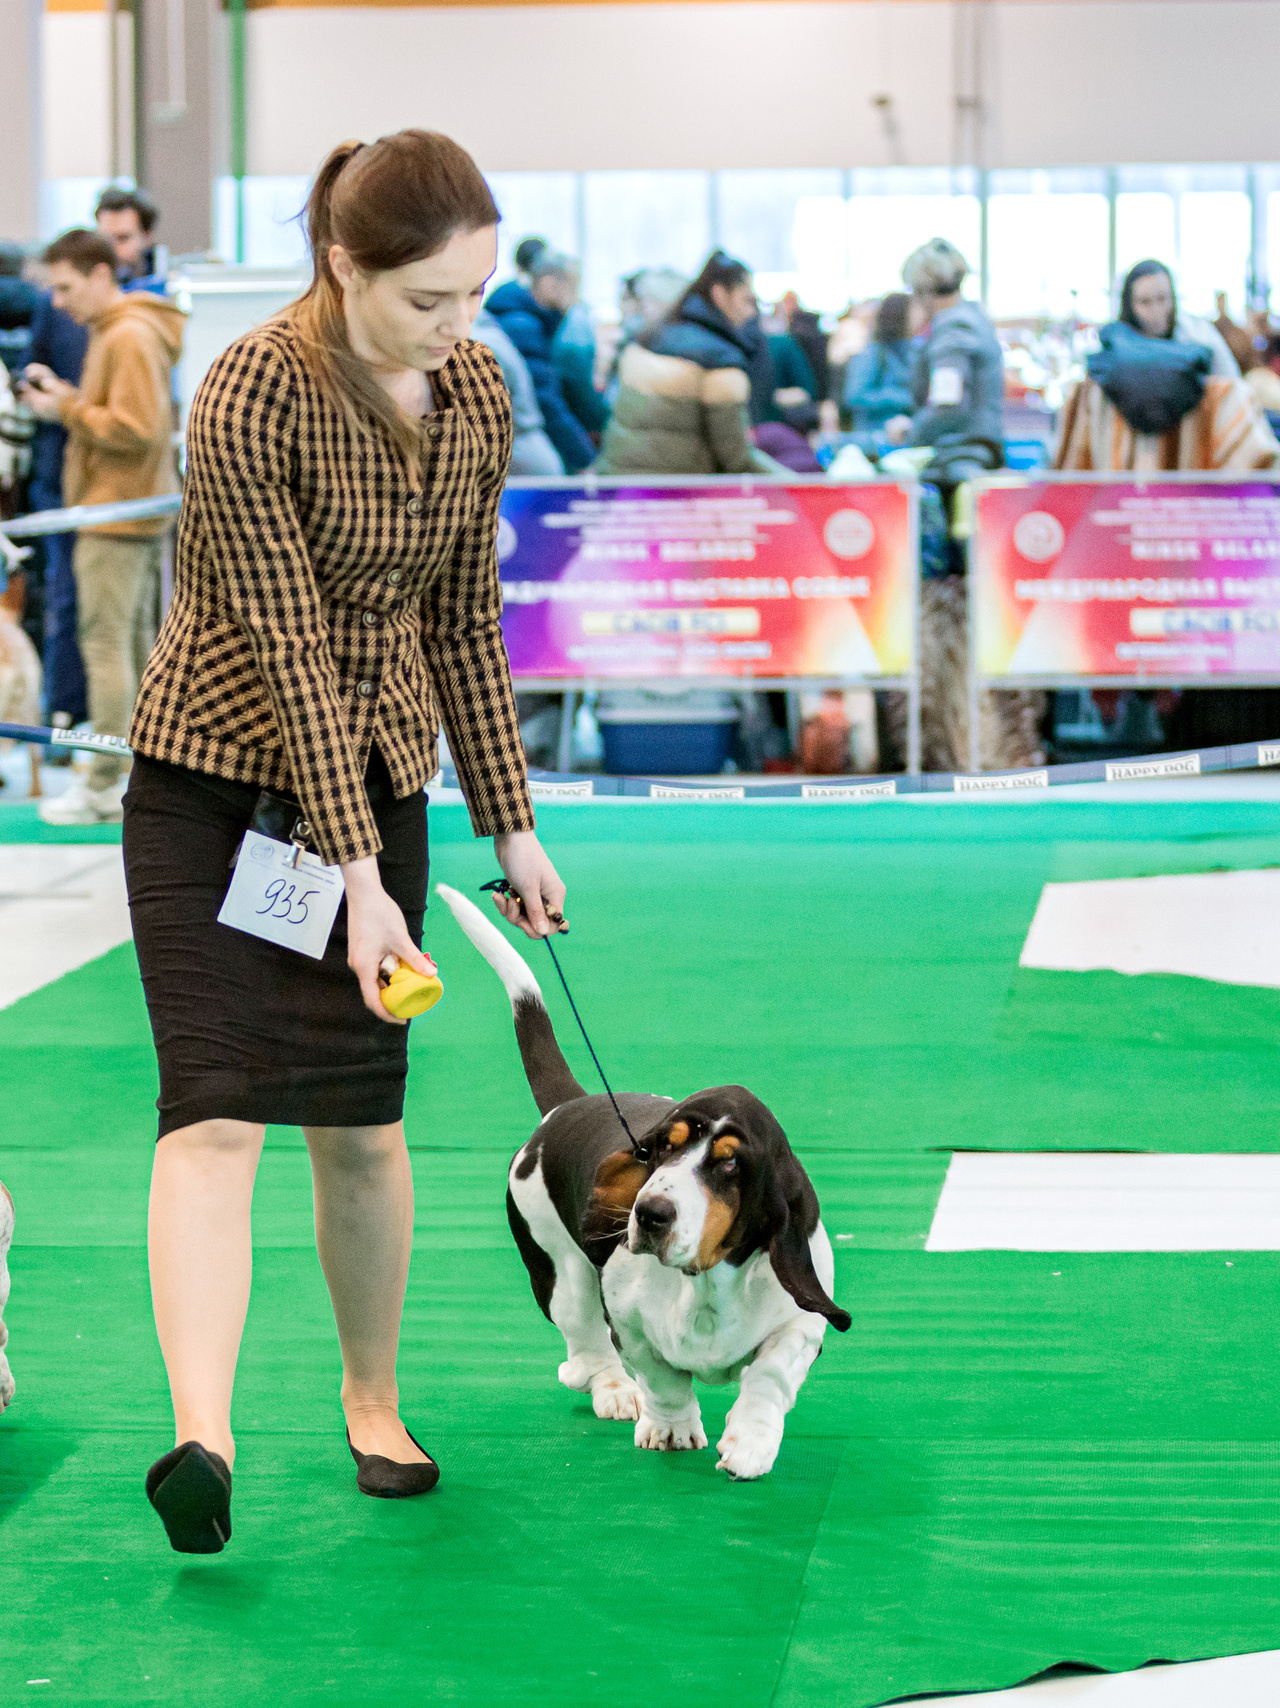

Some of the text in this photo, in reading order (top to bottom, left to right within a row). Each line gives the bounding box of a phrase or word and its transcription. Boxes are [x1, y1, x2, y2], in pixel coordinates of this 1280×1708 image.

[1112, 760, 1195, 779] HAPPY DOG
[959, 775, 1044, 791] HAPPY DOG
[255, 878, 321, 924] 935
